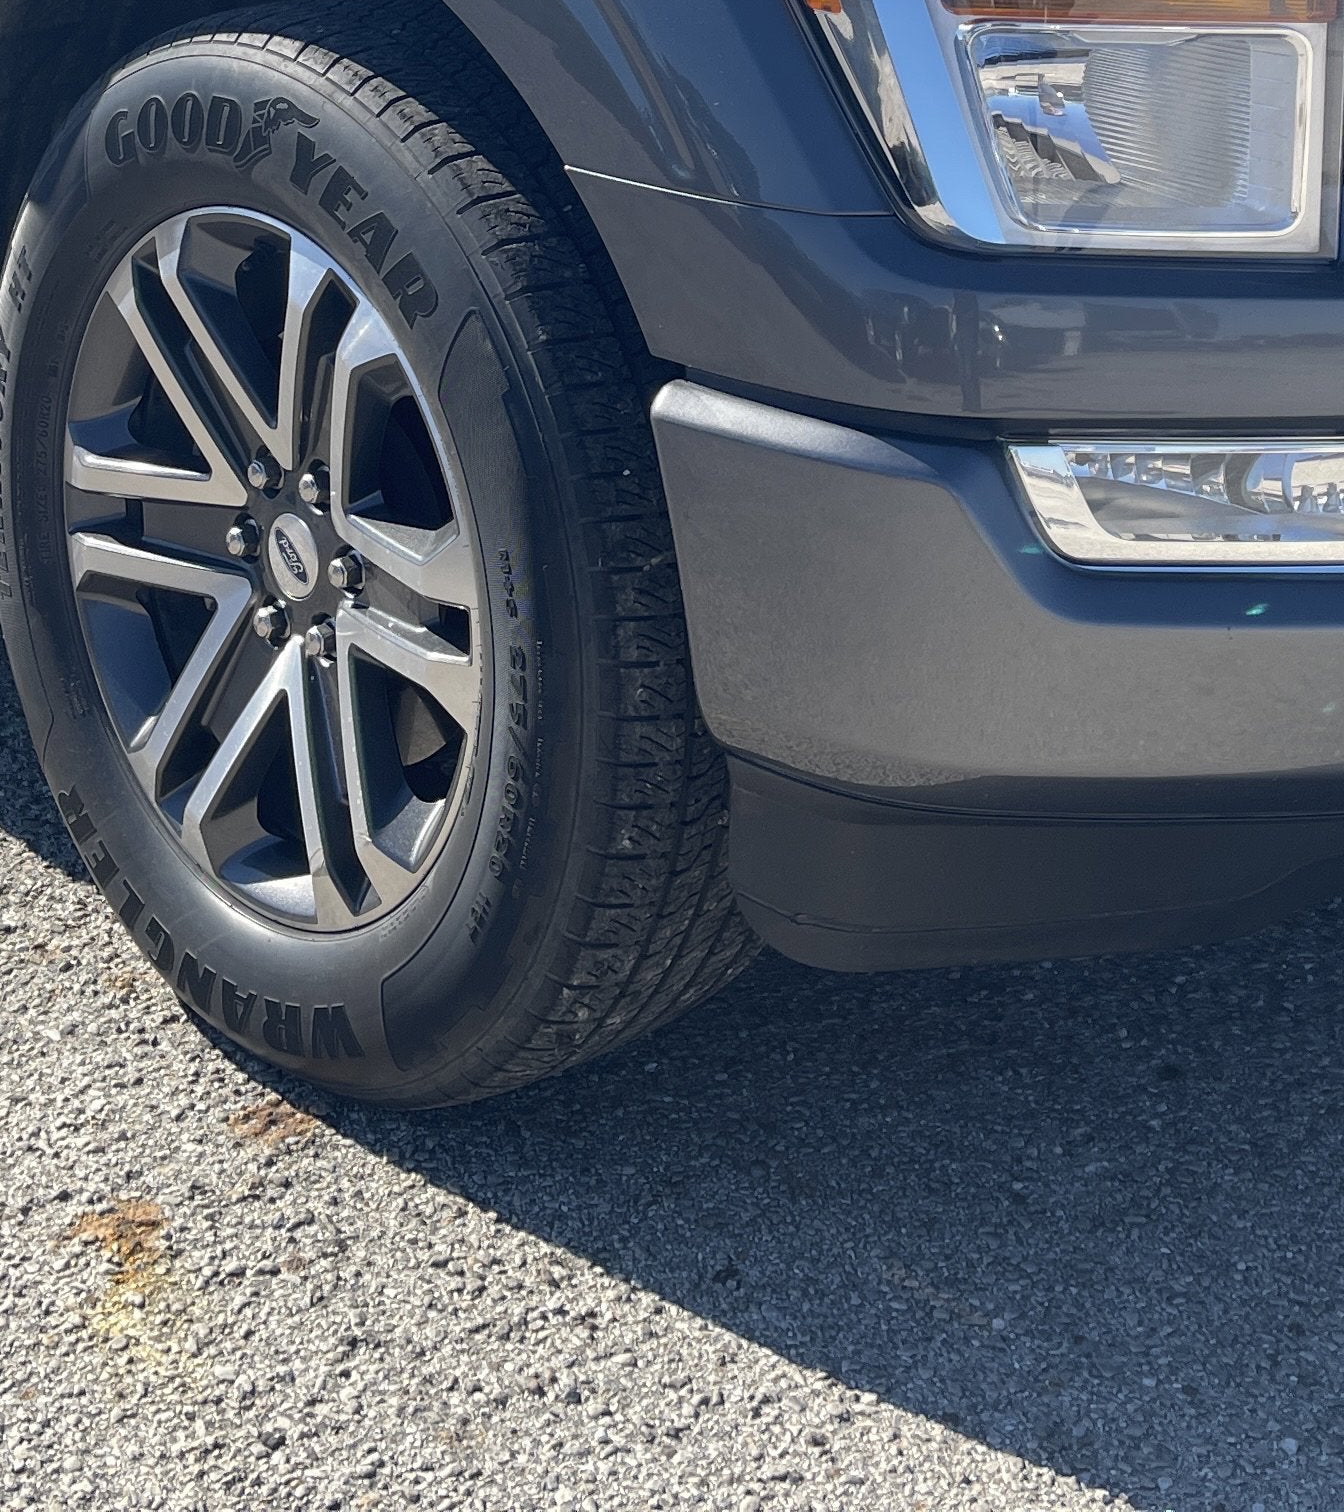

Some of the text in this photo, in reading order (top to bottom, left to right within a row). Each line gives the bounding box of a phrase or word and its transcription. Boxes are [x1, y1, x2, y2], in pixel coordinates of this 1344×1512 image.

[8, 245, 36, 314] HT
[278, 538, 304, 575] Ford
[489, 645, 528, 879] 275/60R20
[58, 785, 365, 1059] WRANGLER
